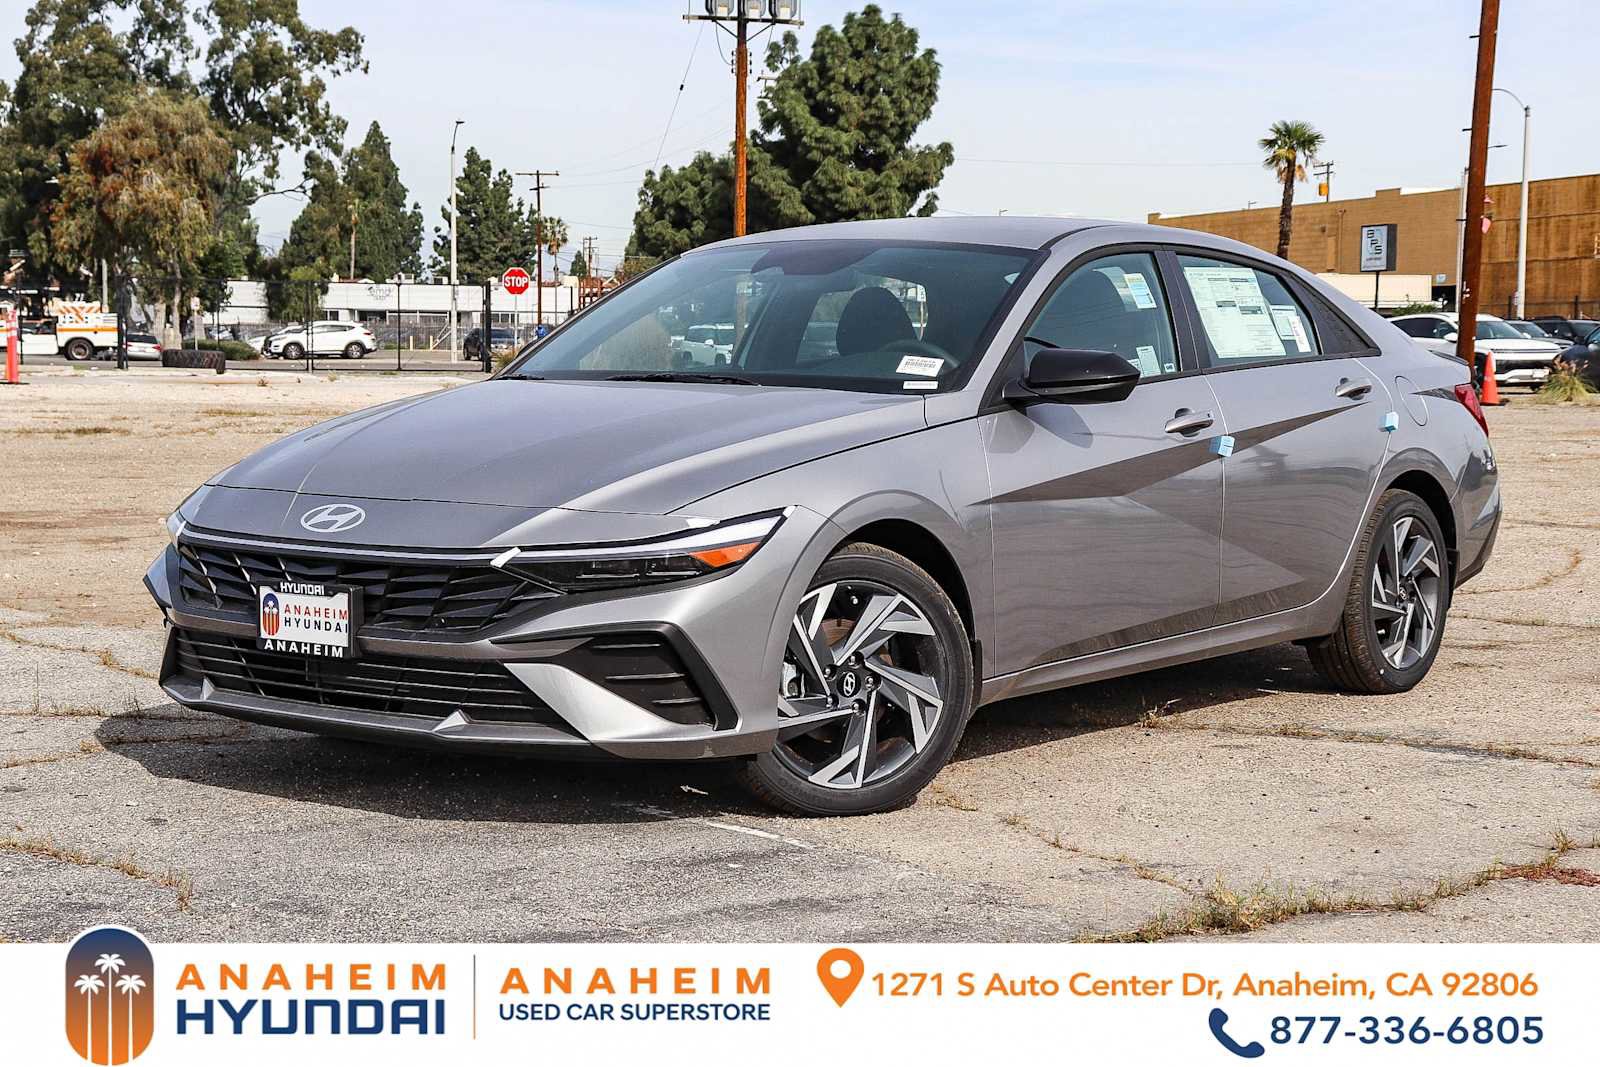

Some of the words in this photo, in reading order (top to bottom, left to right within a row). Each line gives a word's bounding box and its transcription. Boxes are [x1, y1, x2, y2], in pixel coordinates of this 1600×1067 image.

[504, 276, 528, 288] STOP
[280, 582, 325, 595] HYUNDAI
[284, 604, 348, 620] ANAHEIM
[284, 617, 348, 633] HYUNDAI
[264, 639, 343, 658] ANAHEIM
